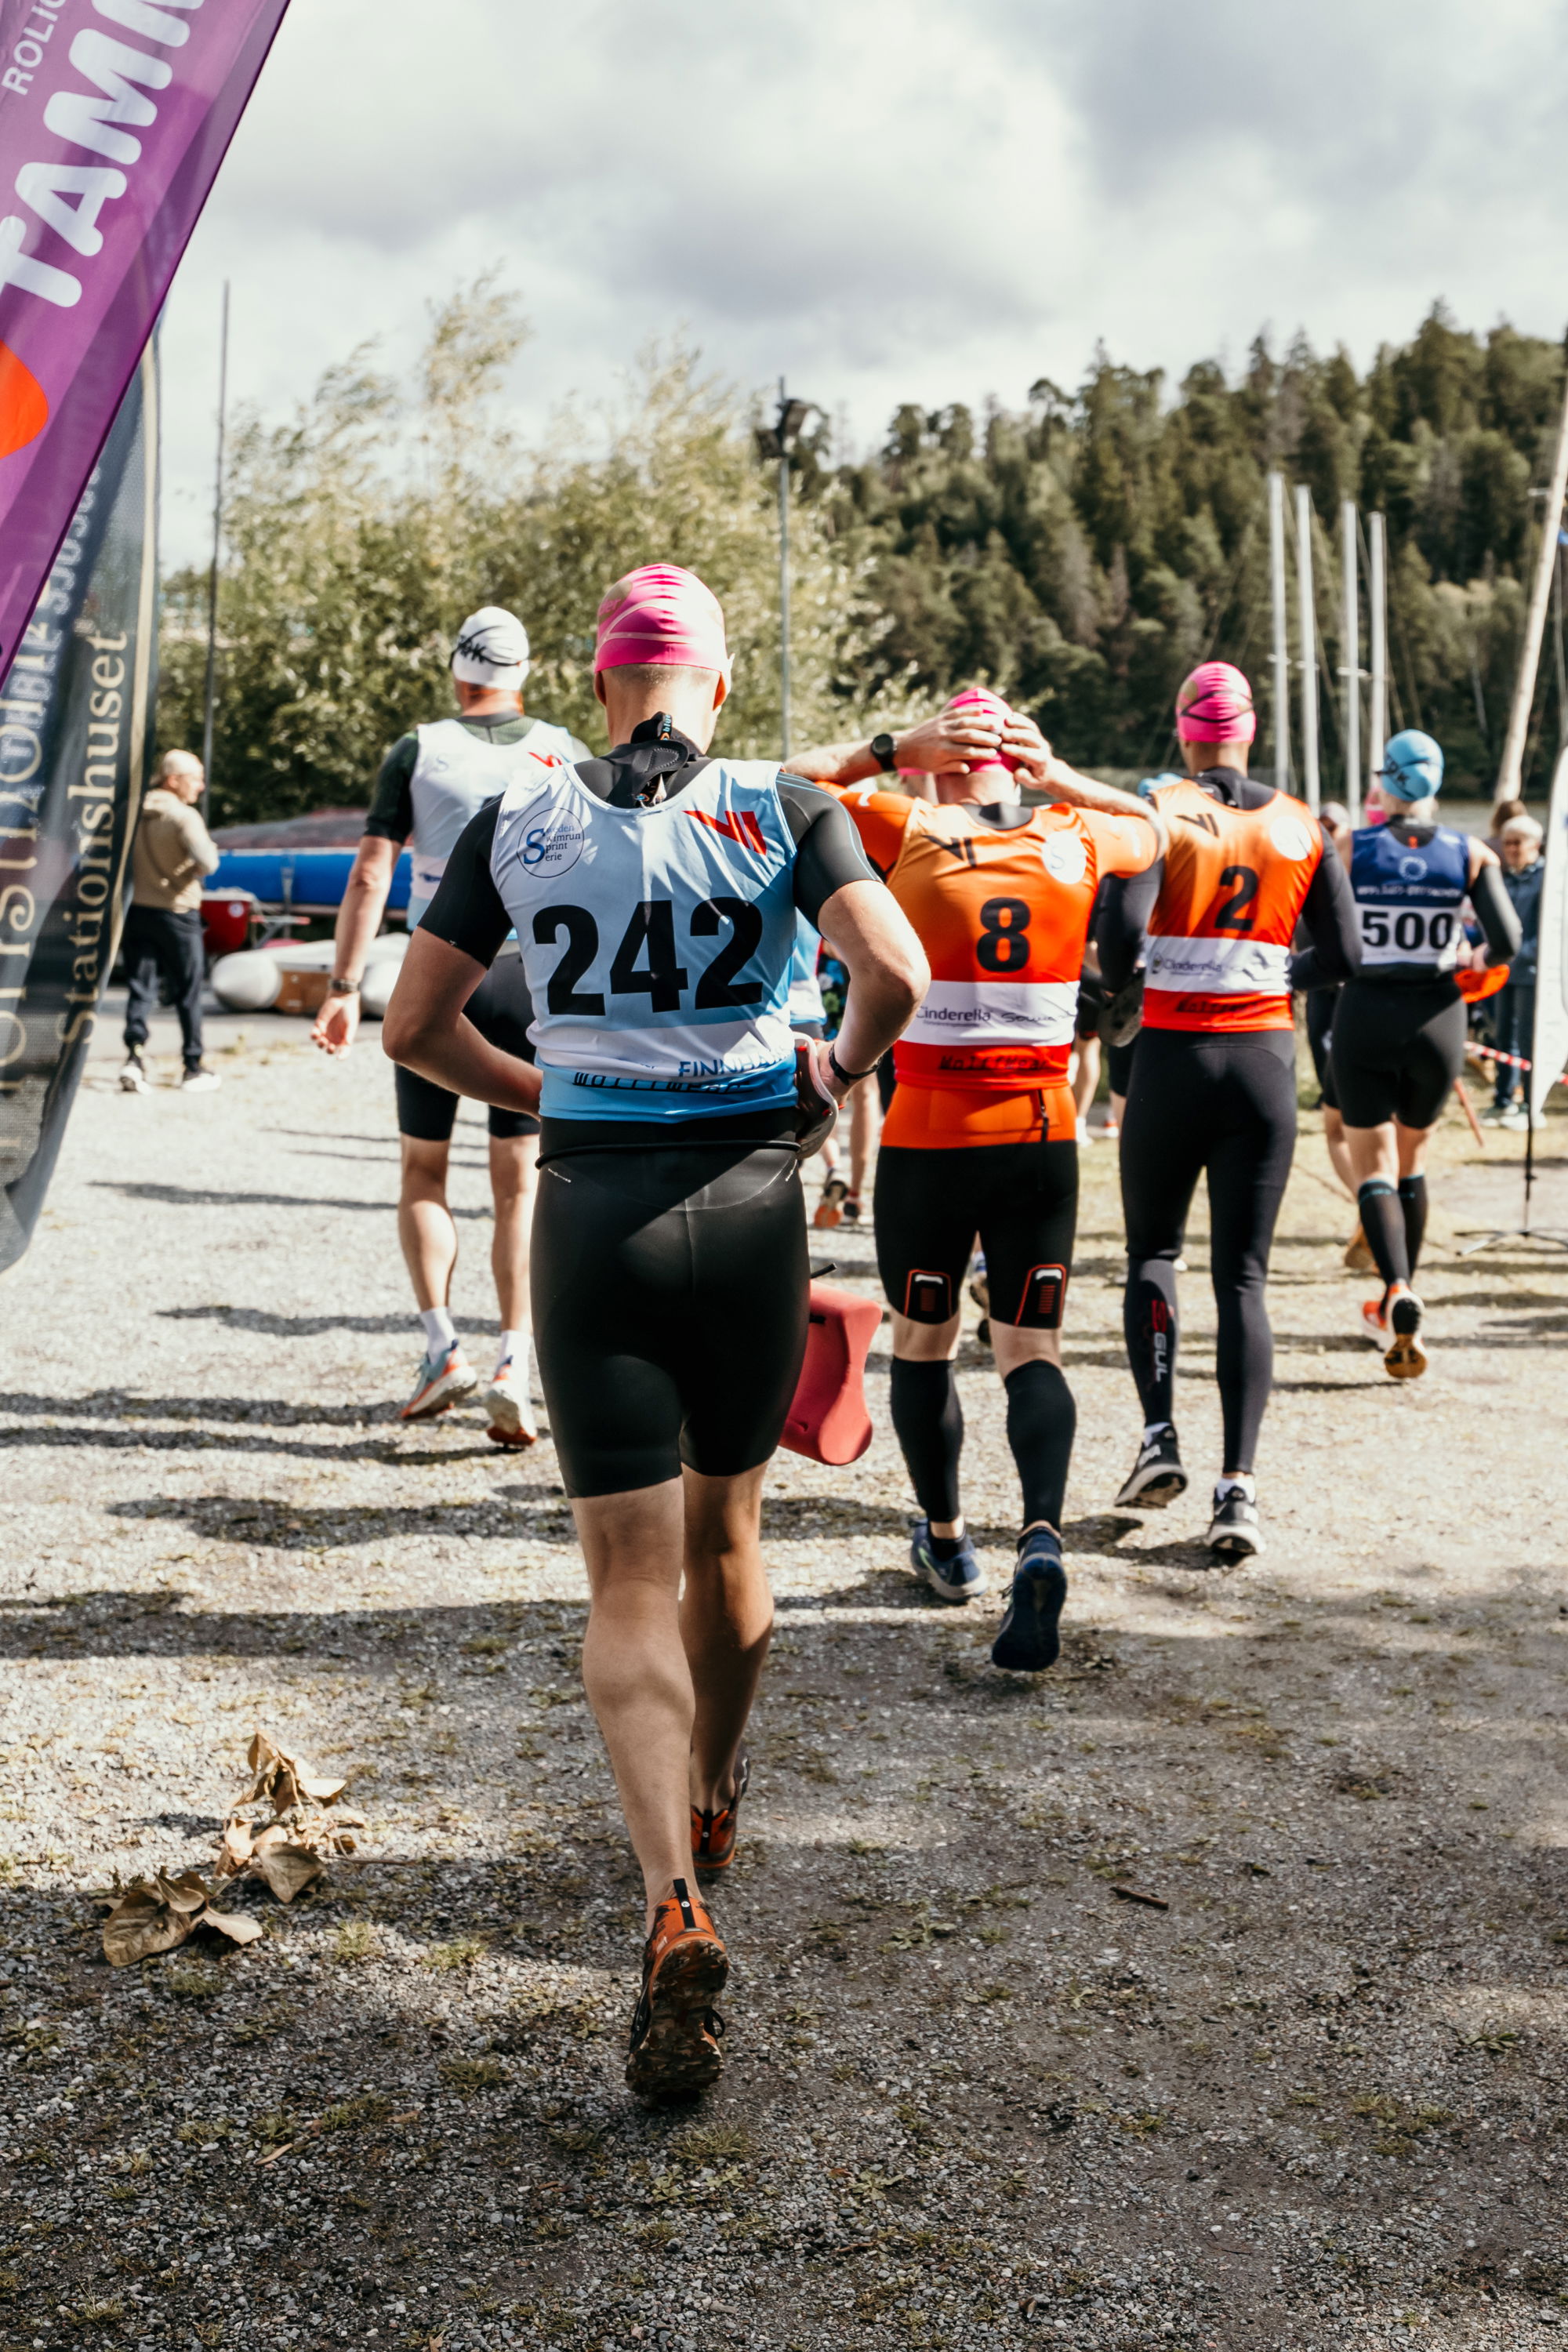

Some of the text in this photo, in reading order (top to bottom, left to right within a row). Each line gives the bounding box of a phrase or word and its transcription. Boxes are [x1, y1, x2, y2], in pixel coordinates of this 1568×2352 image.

[55, 630, 128, 1044] Stationshuset
[1214, 865, 1260, 931] 2
[1362, 910, 1454, 951] 500
[532, 896, 764, 1016] 242
[976, 897, 1030, 972] 8
[917, 1006, 992, 1022] Cinderella
[1153, 1332, 1168, 1382] GUL
